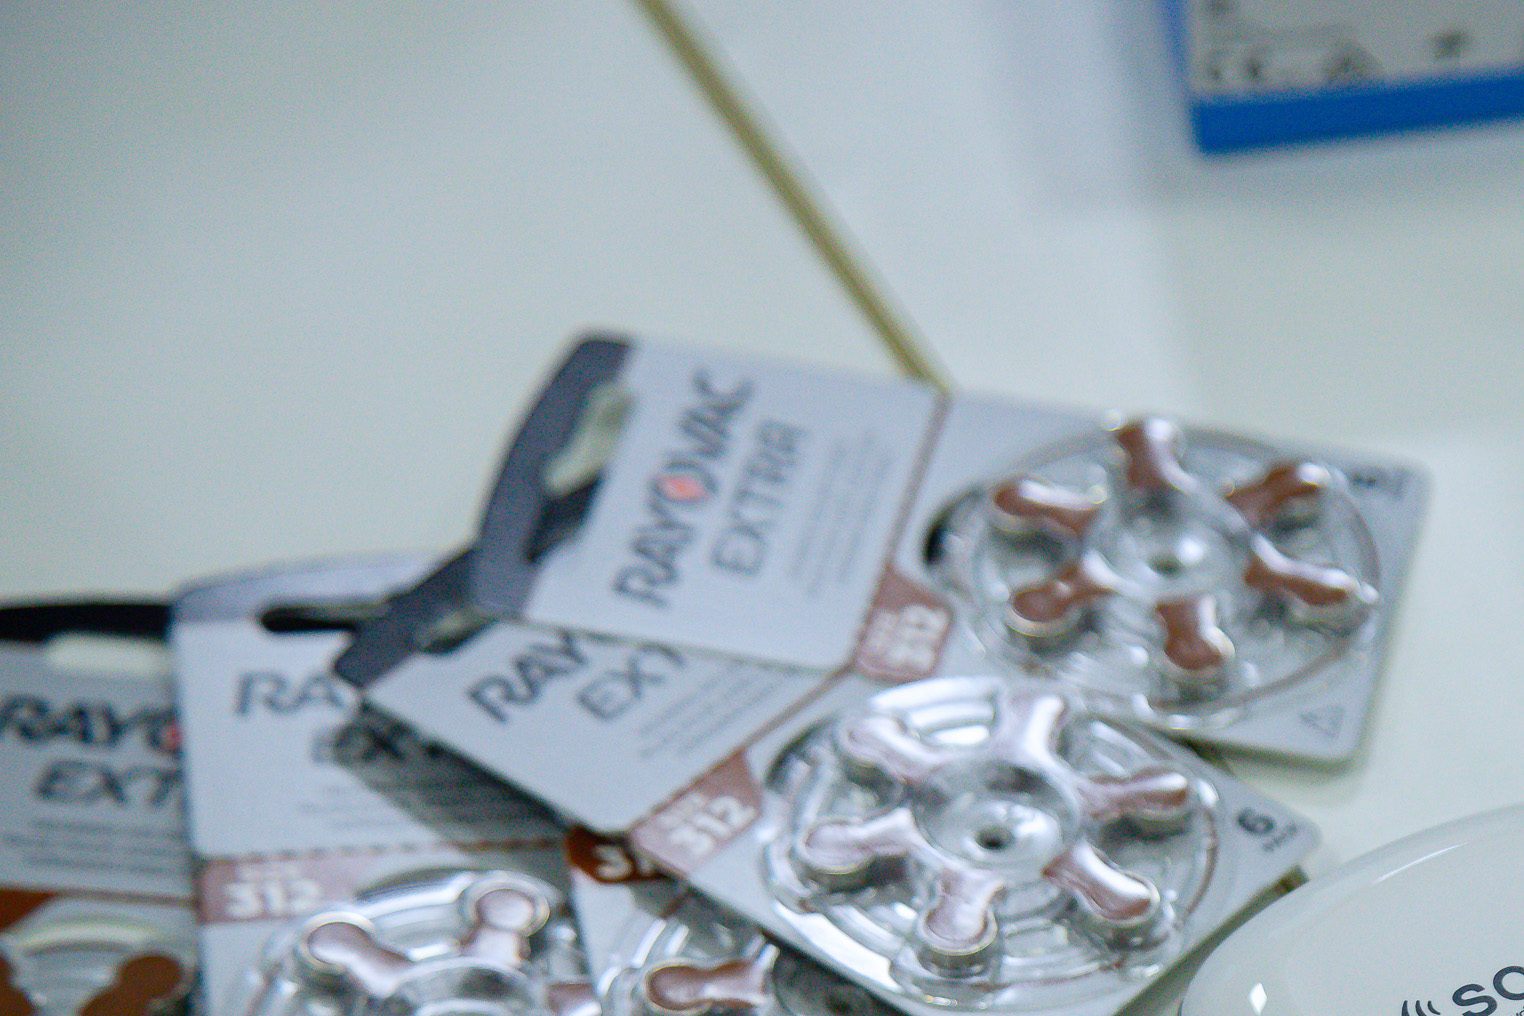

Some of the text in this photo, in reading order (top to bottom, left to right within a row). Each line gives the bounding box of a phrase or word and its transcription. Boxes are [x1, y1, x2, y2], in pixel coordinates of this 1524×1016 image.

[610, 366, 757, 609] RAYOVAC
[708, 416, 806, 577] EXTRA
[232, 670, 346, 717] RA
[0, 692, 184, 760] RAYO
[35, 759, 186, 809] EXT
[1236, 805, 1277, 838] 6
